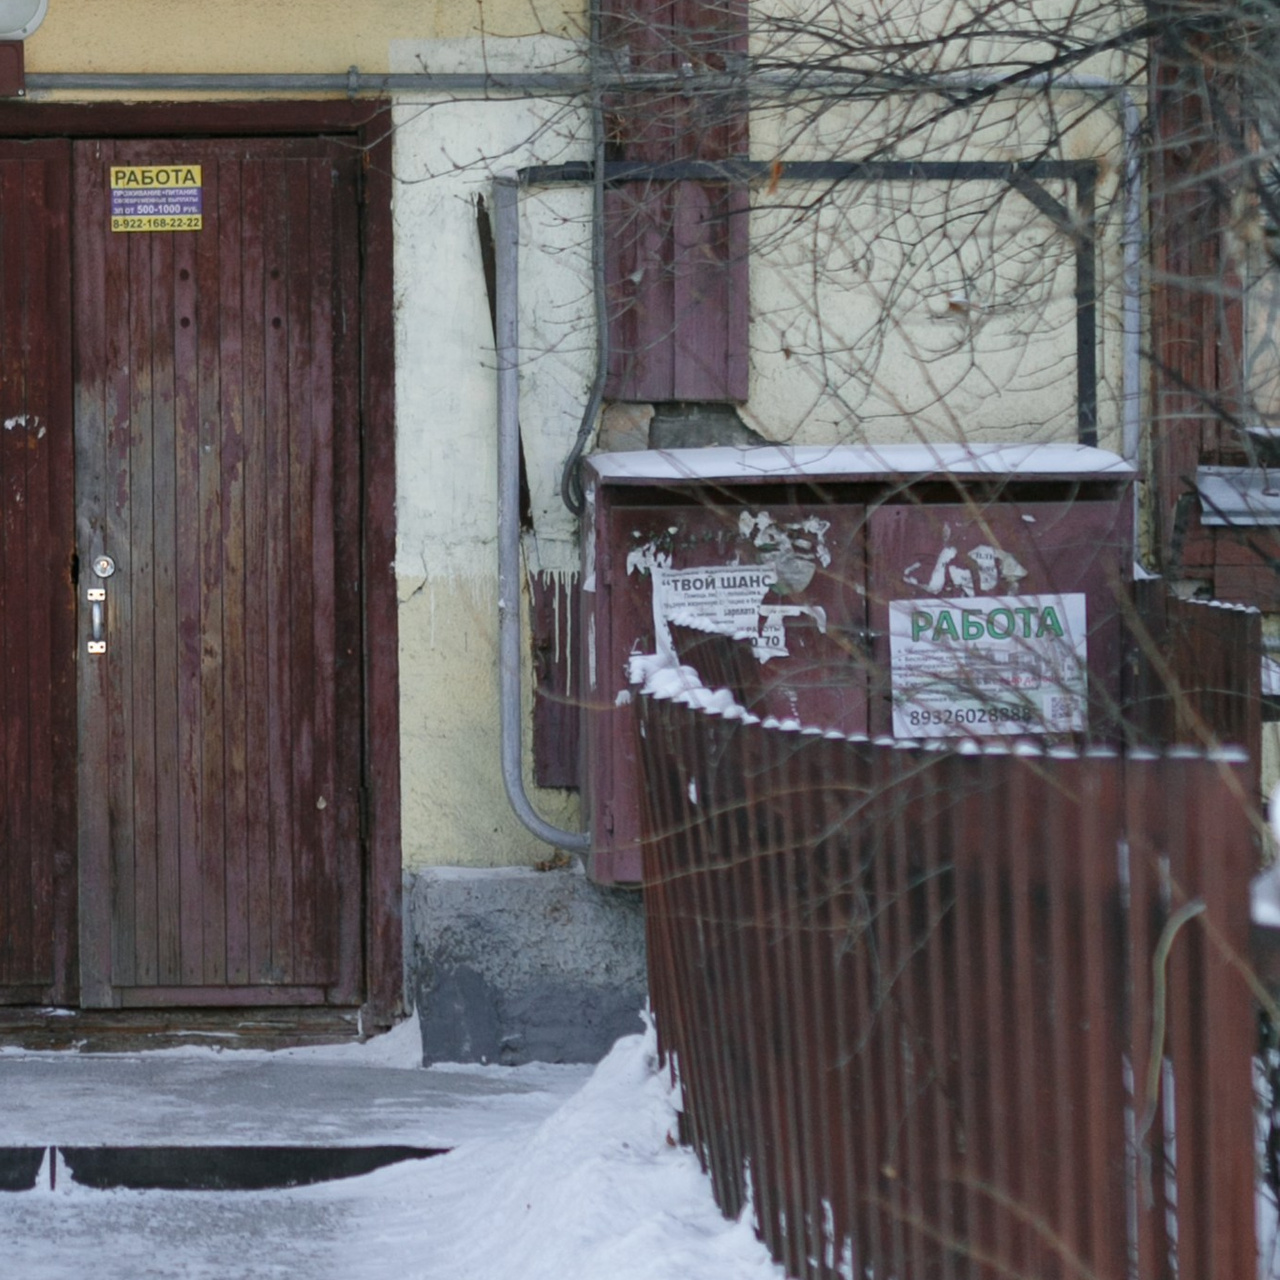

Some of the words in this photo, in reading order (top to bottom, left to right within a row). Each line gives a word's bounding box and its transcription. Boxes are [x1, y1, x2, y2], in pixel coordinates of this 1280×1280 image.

[114, 169, 196, 185] РАБОТА
[125, 206, 134, 214] ОТ
[137, 204, 181, 214] 500-1000
[113, 218, 200, 229] 8-922-168-22-22
[721, 574, 774, 589] ШАНС
[910, 606, 1064, 642] РАБОТА
